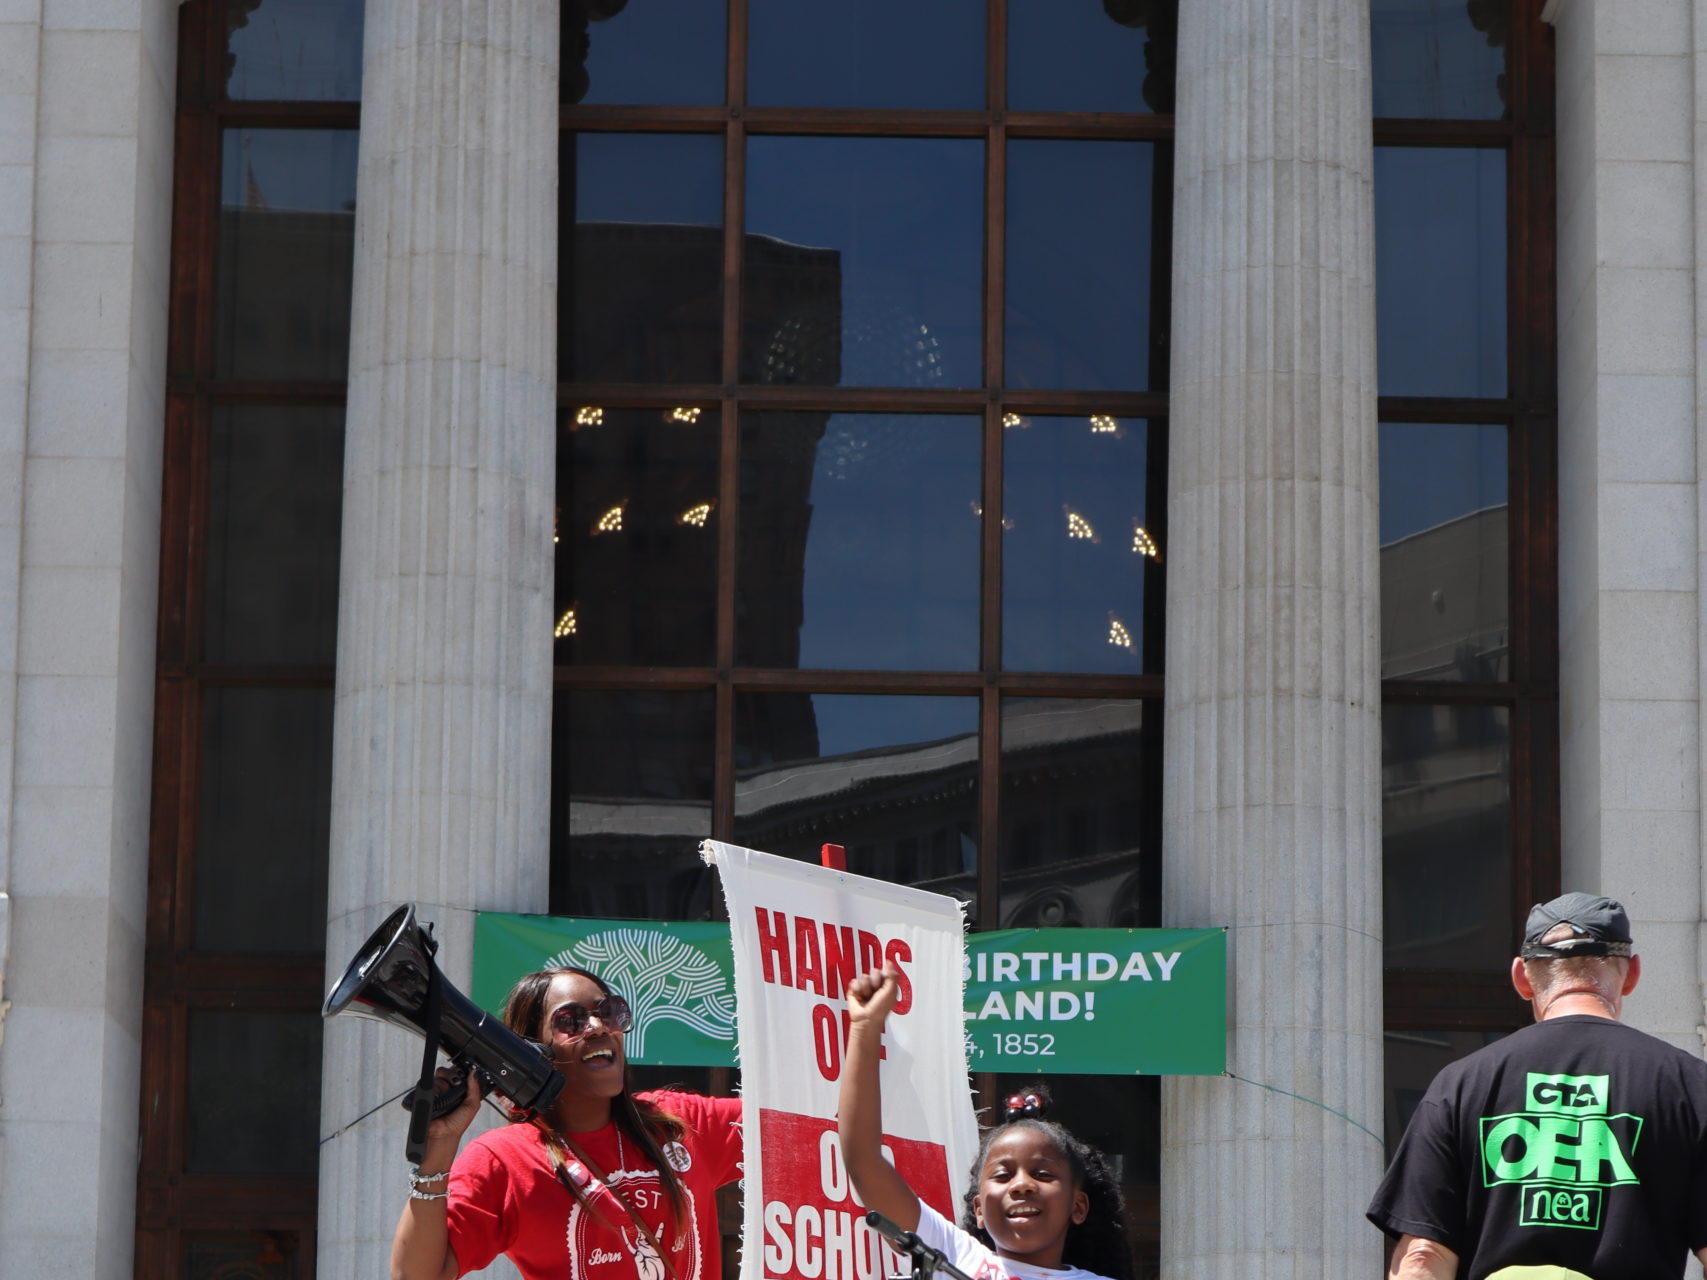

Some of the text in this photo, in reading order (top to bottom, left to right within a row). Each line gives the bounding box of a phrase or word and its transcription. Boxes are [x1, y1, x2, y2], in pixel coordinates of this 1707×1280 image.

[755, 906, 912, 1015] HANDS
[993, 1034, 1055, 1056] 1852
[1533, 1082, 1599, 1107] CTA
[1486, 1117, 1637, 1181] OEA
[1530, 1190, 1590, 1222] nea
[588, 1248, 622, 1266] Born
